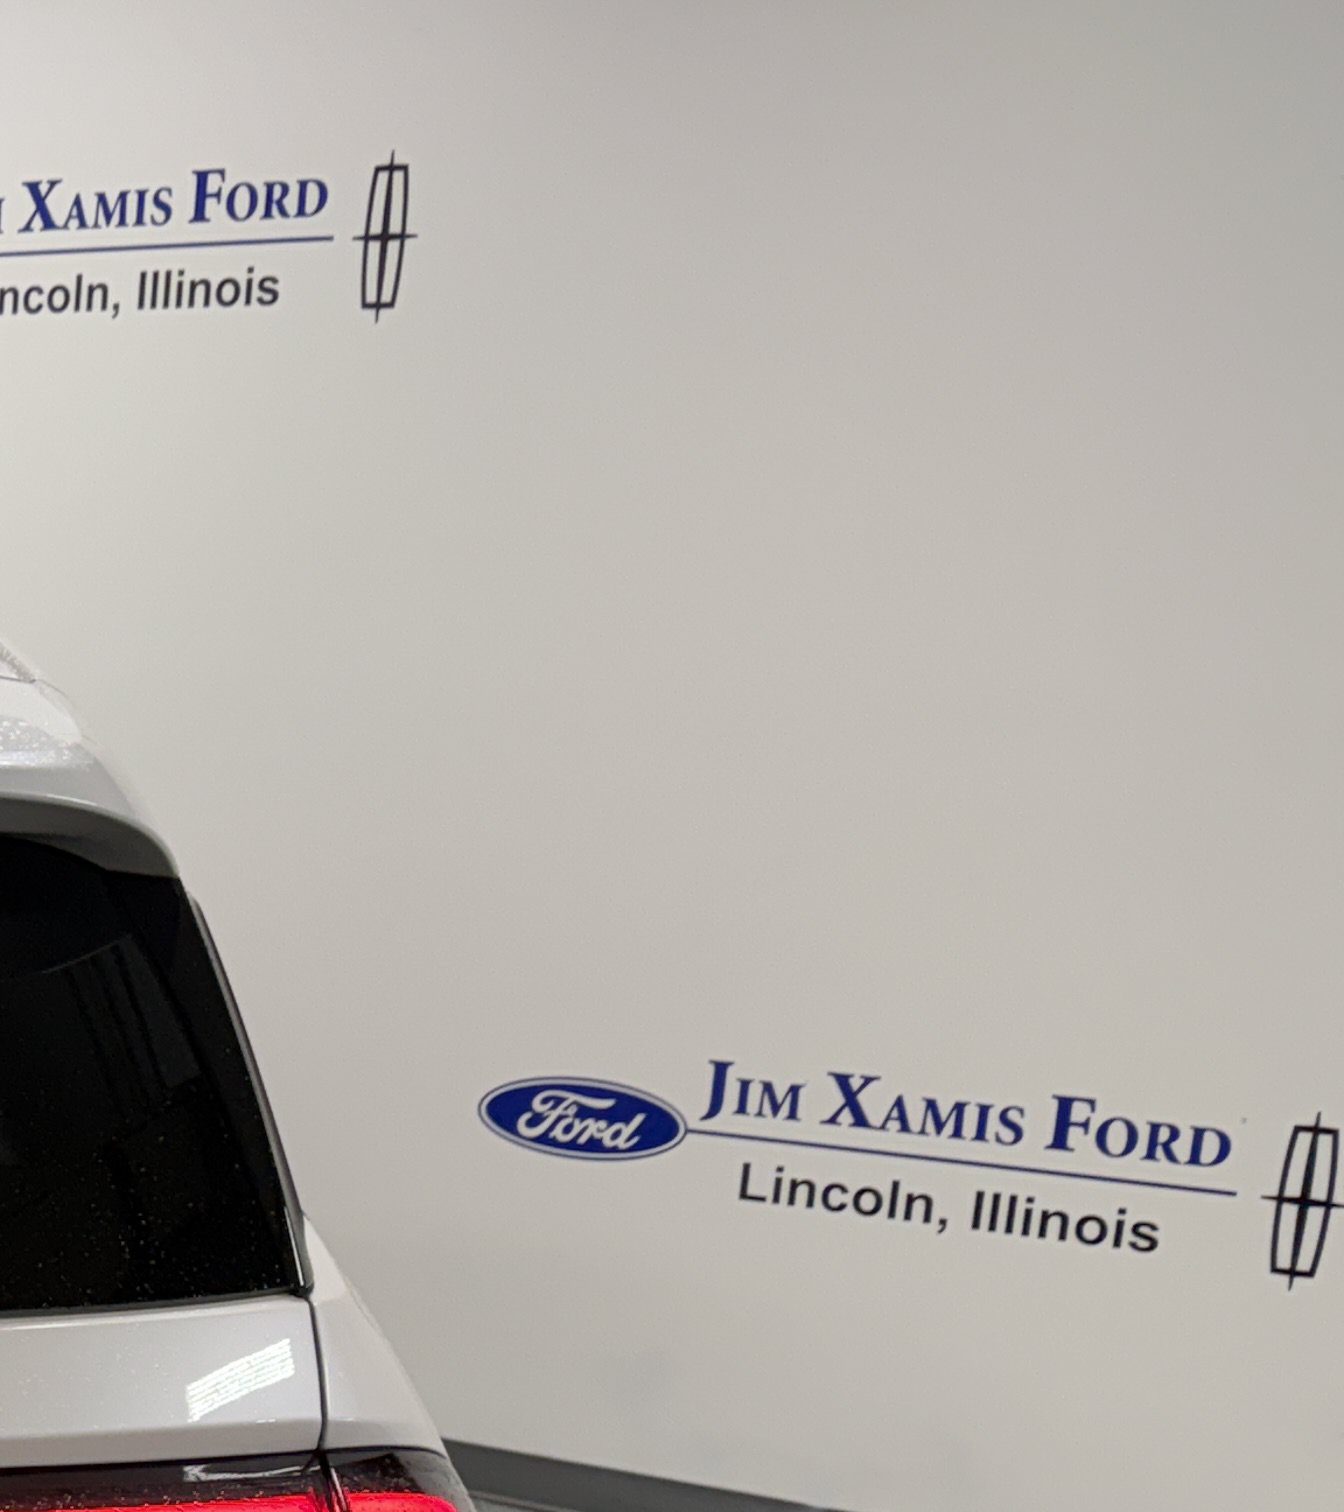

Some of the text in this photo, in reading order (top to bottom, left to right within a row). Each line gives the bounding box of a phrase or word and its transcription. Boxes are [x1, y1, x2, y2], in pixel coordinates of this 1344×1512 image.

[19, 180, 172, 232] XAMIS
[189, 169, 328, 223] FORD
[138, 267, 279, 309] Illinois
[514, 1089, 643, 1151] Ford
[700, 1061, 1232, 1169] JIM XAMIS FORD
[739, 1162, 1161, 1253] Lincoln, Illinois
